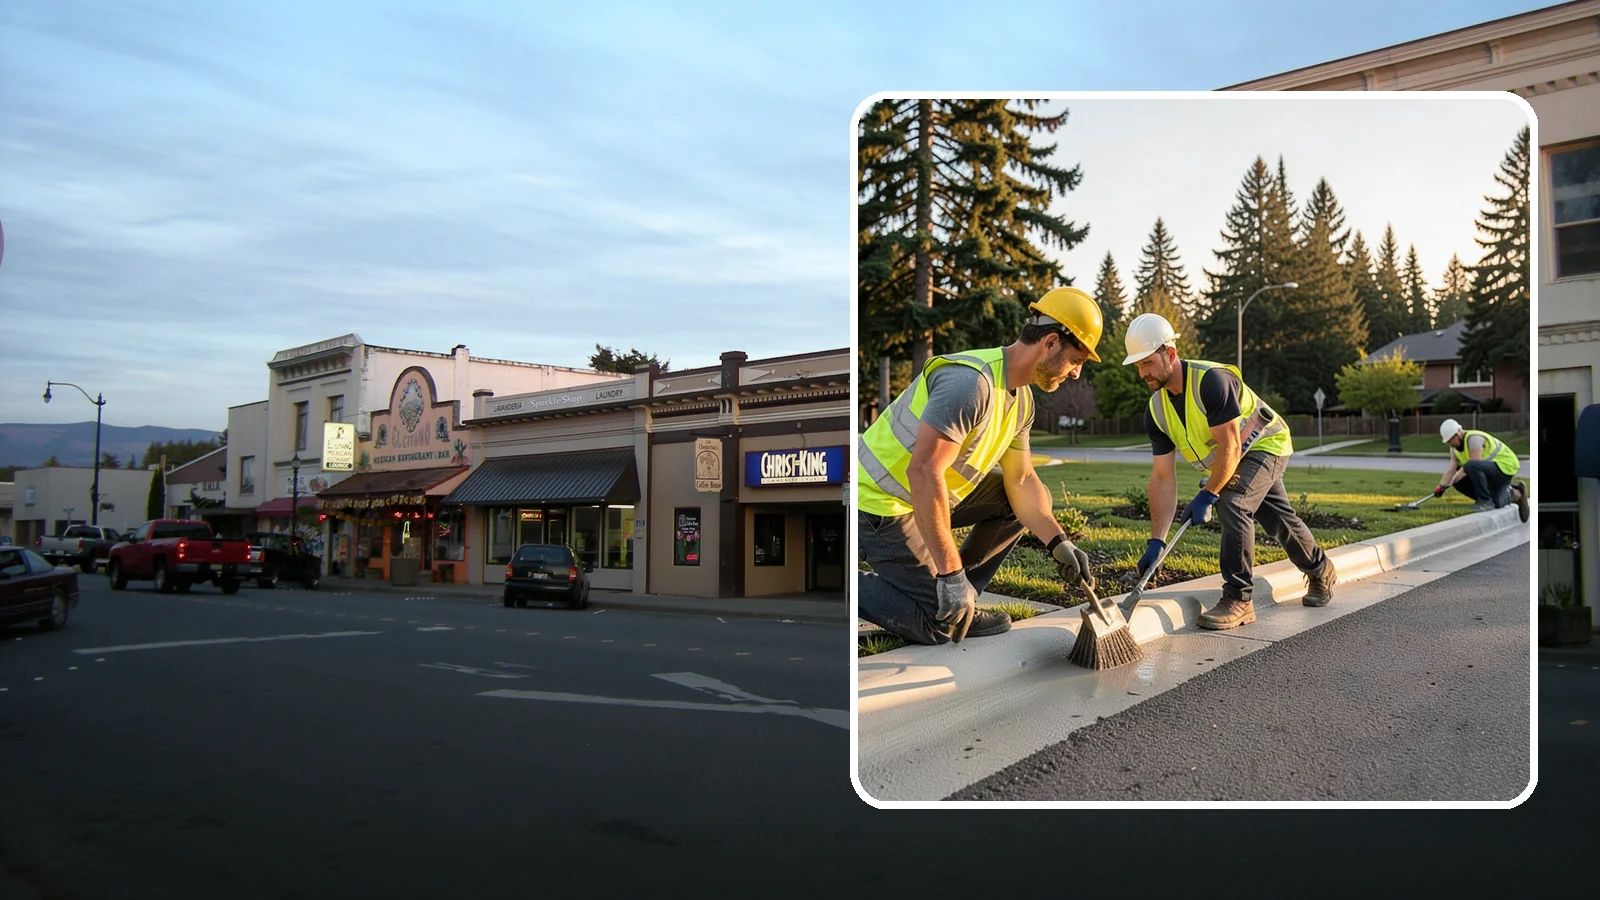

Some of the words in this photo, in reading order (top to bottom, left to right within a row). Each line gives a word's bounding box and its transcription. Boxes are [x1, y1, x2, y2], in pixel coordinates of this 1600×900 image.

[493, 402, 523, 413] LAVANDERIA
[530, 396, 561, 409] Sparkle
[561, 394, 582, 405] Shop
[595, 389, 624, 400] LAUNDRY
[373, 455, 396, 464] MEXICAN
[397, 452, 433, 462] RESTAURANT
[438, 450, 450, 459] BAR
[761, 452, 797, 478] CHRIST
[799, 450, 828, 477] KING
[696, 481, 709, 489] Coffee
